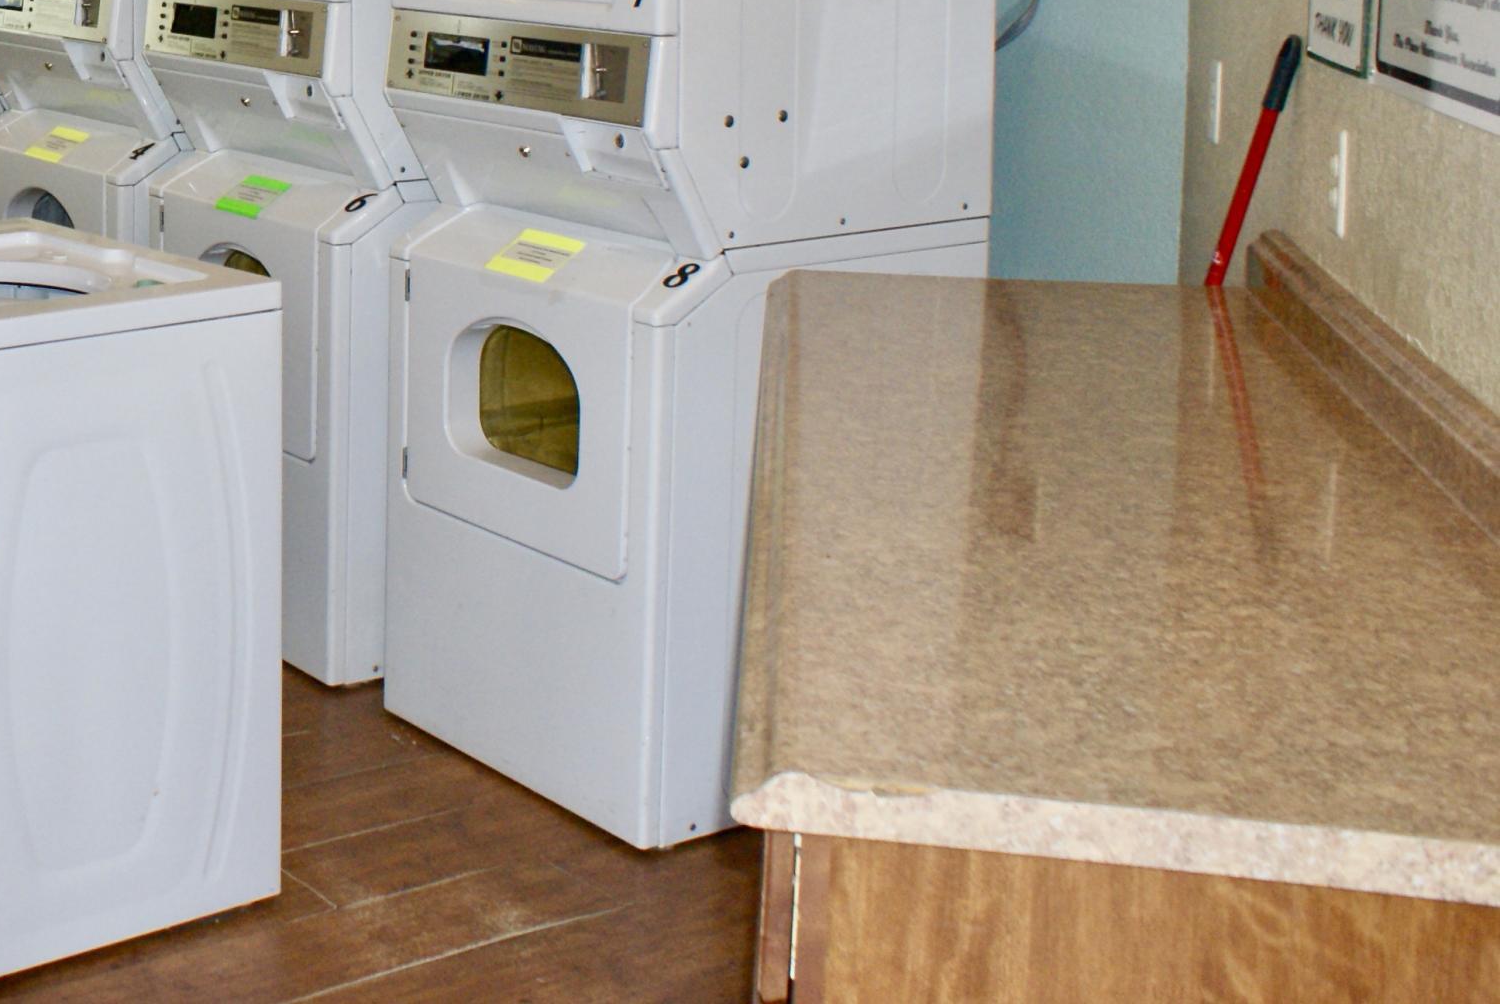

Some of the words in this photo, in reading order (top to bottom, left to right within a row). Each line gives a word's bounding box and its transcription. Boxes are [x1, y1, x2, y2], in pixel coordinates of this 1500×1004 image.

[129, 141, 156, 161] 4
[344, 193, 379, 213] 6
[662, 262, 701, 289] 8
